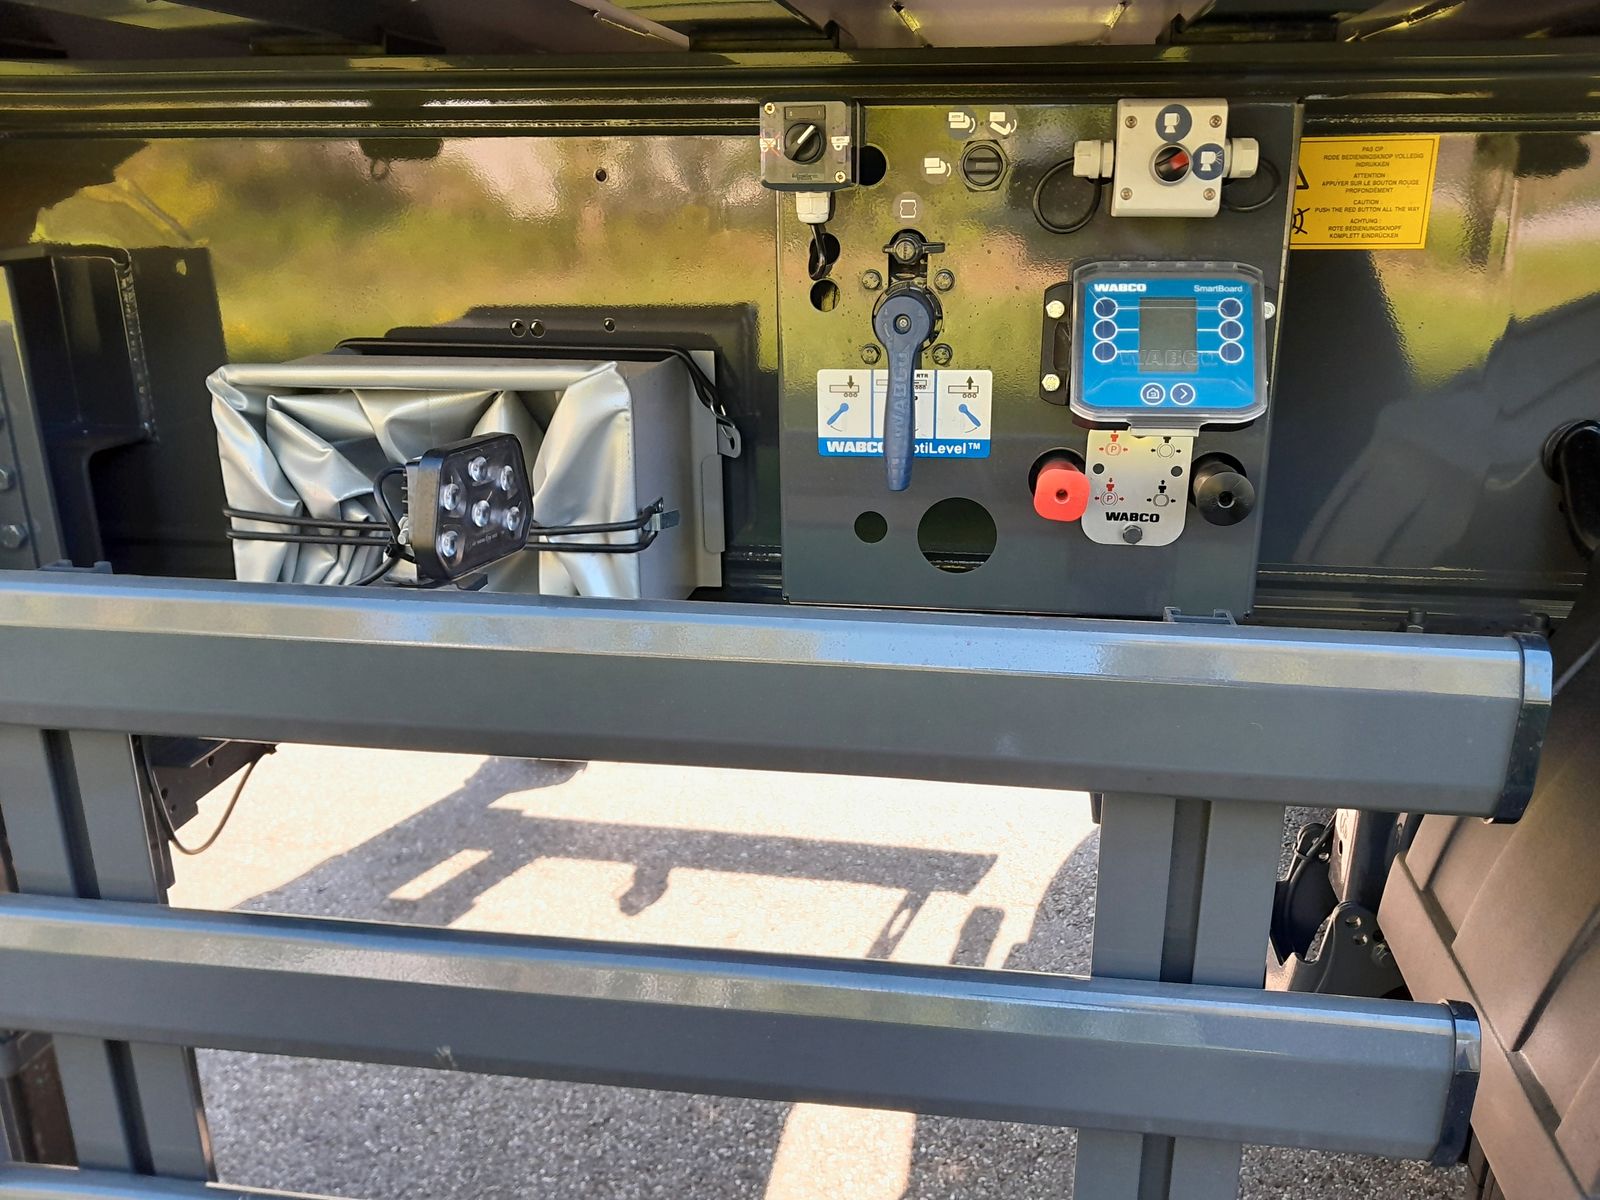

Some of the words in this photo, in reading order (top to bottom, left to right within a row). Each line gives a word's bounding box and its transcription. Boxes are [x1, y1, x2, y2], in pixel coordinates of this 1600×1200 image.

[1094, 283, 1147, 292] WABCO
[1193, 284, 1243, 293] SmartBoard
[1118, 349, 1219, 366] WABCO
[1105, 511, 1160, 523] WABCO
